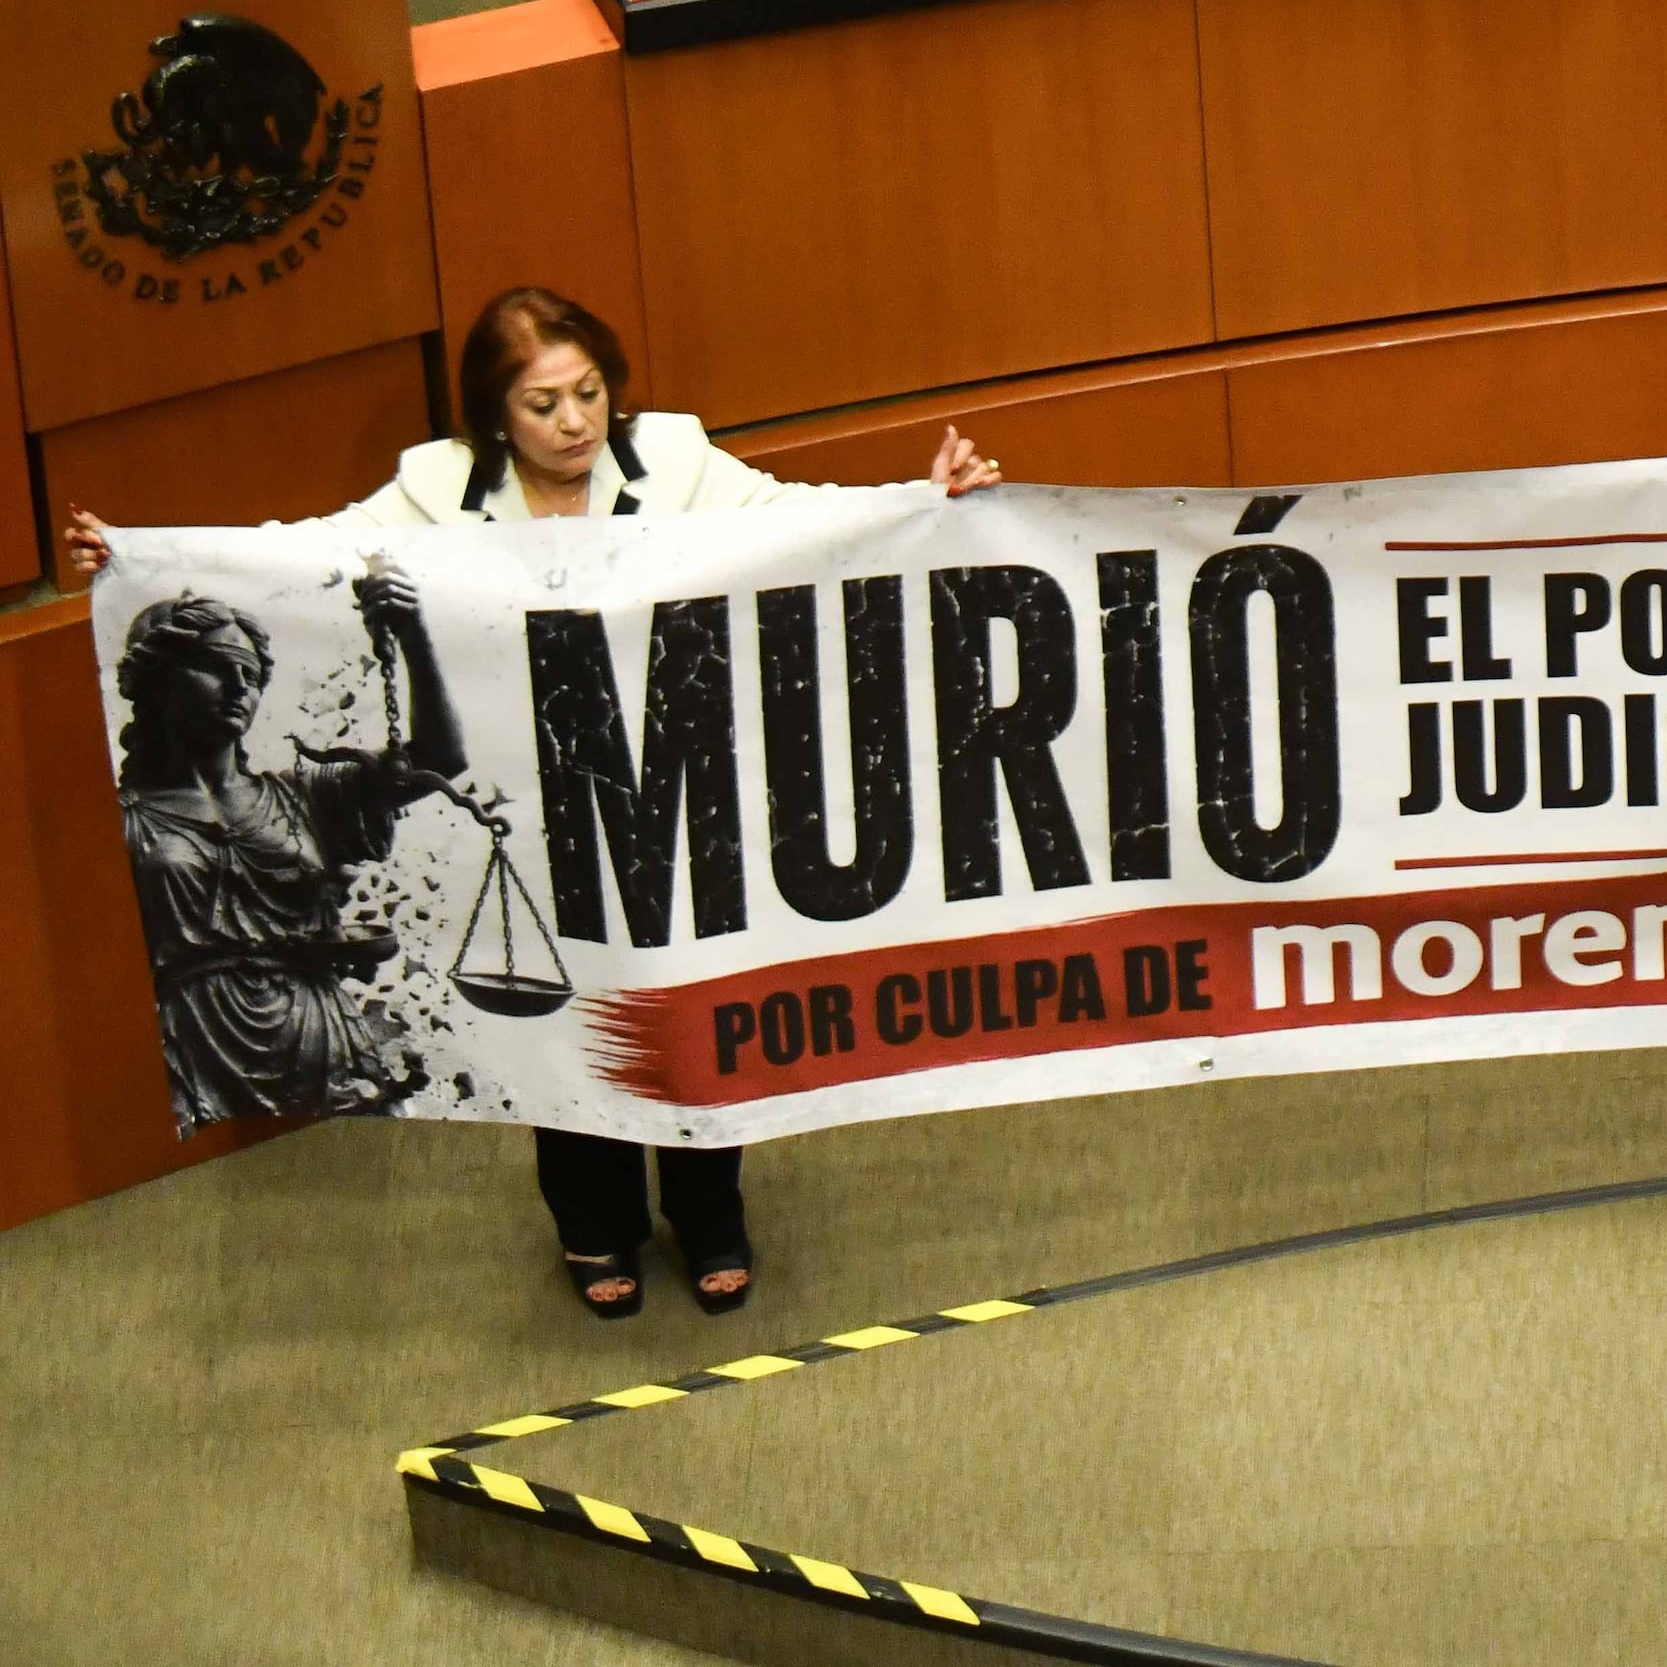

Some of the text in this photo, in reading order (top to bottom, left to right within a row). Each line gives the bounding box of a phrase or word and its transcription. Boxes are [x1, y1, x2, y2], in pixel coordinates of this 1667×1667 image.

[52, 157, 127, 286] SENADO
[134, 273, 181, 303] DE
[201, 273, 247, 302] LA
[1395, 575, 1513, 685] EL
[525, 493, 1342, 949] MURIÓ
[712, 983, 857, 1078] POR
[873, 951, 1108, 1047] CULPA
[1122, 937, 1215, 1020] DE
